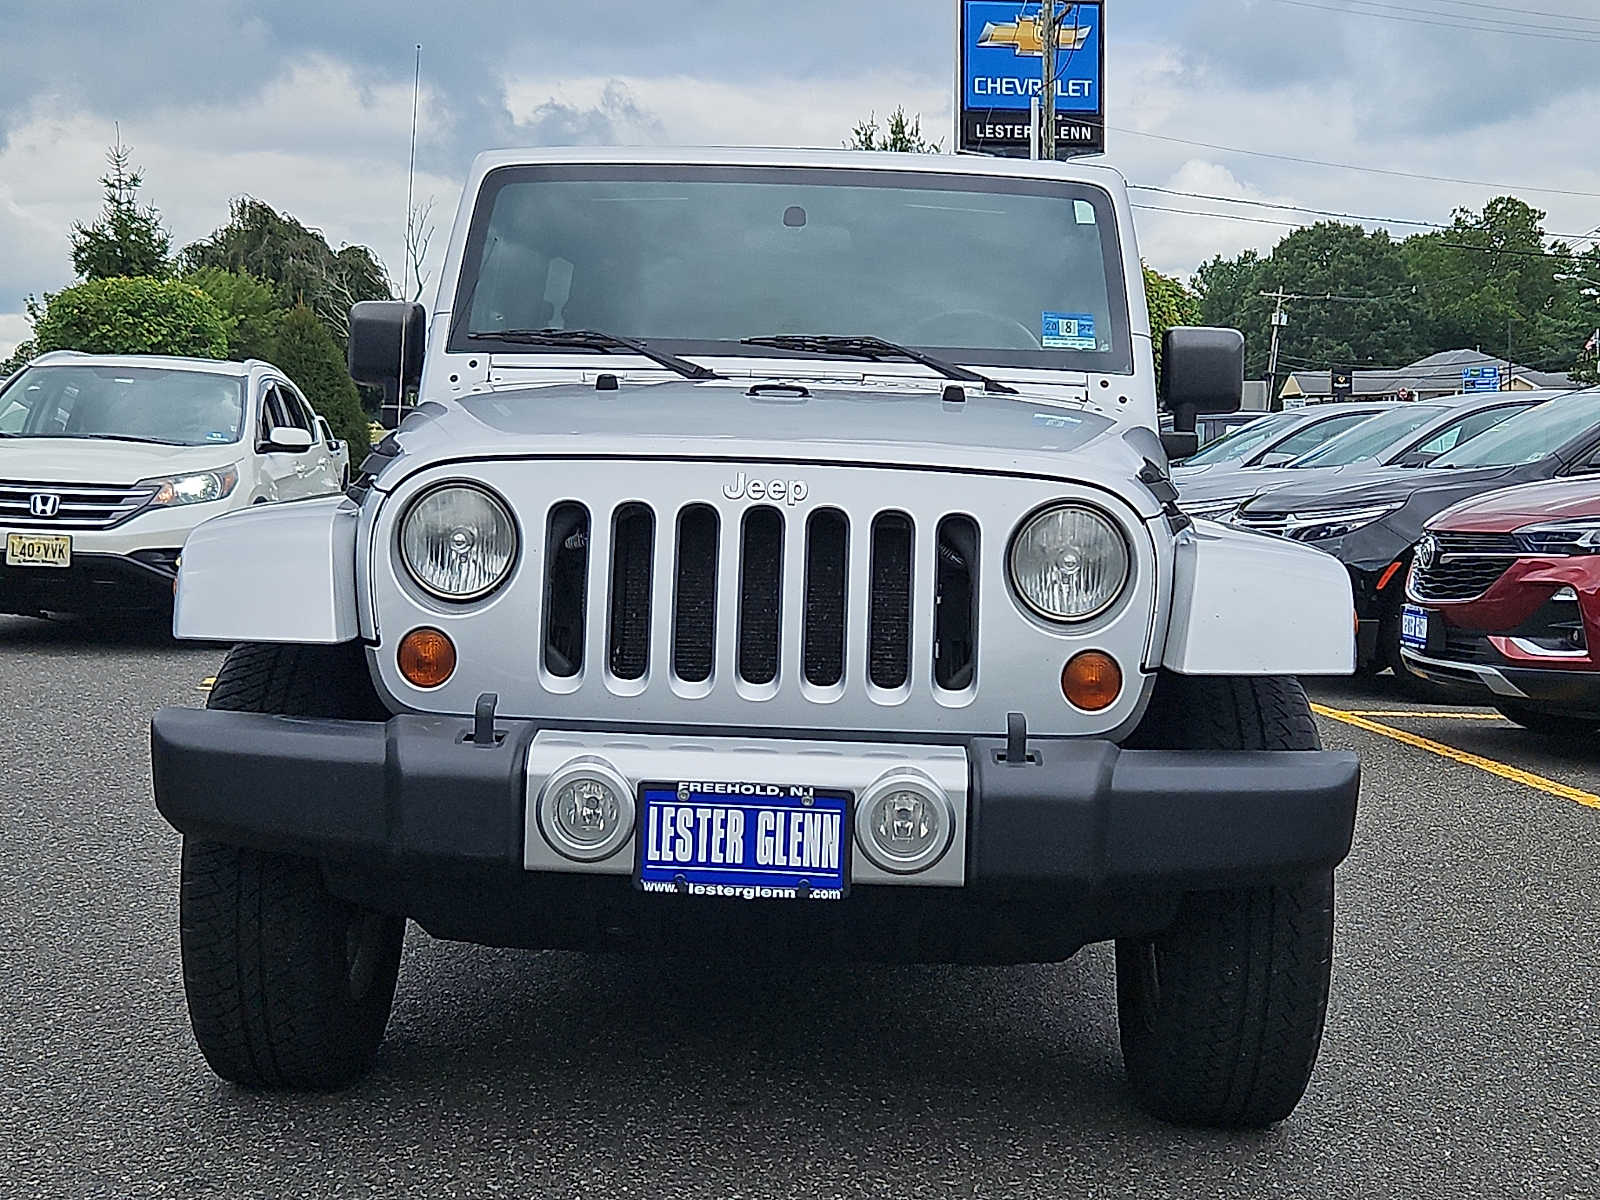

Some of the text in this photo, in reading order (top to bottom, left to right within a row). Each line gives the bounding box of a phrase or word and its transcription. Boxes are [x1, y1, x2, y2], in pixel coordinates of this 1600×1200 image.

[974, 77, 1093, 97] CHEVRLET
[1065, 320, 1072, 334] 8
[723, 471, 808, 506] Jeep
[678, 782, 784, 798] FREEHOLD,
[647, 805, 842, 869] LESTER GLENN
[643, 881, 841, 900] www. lesterglenn .com
